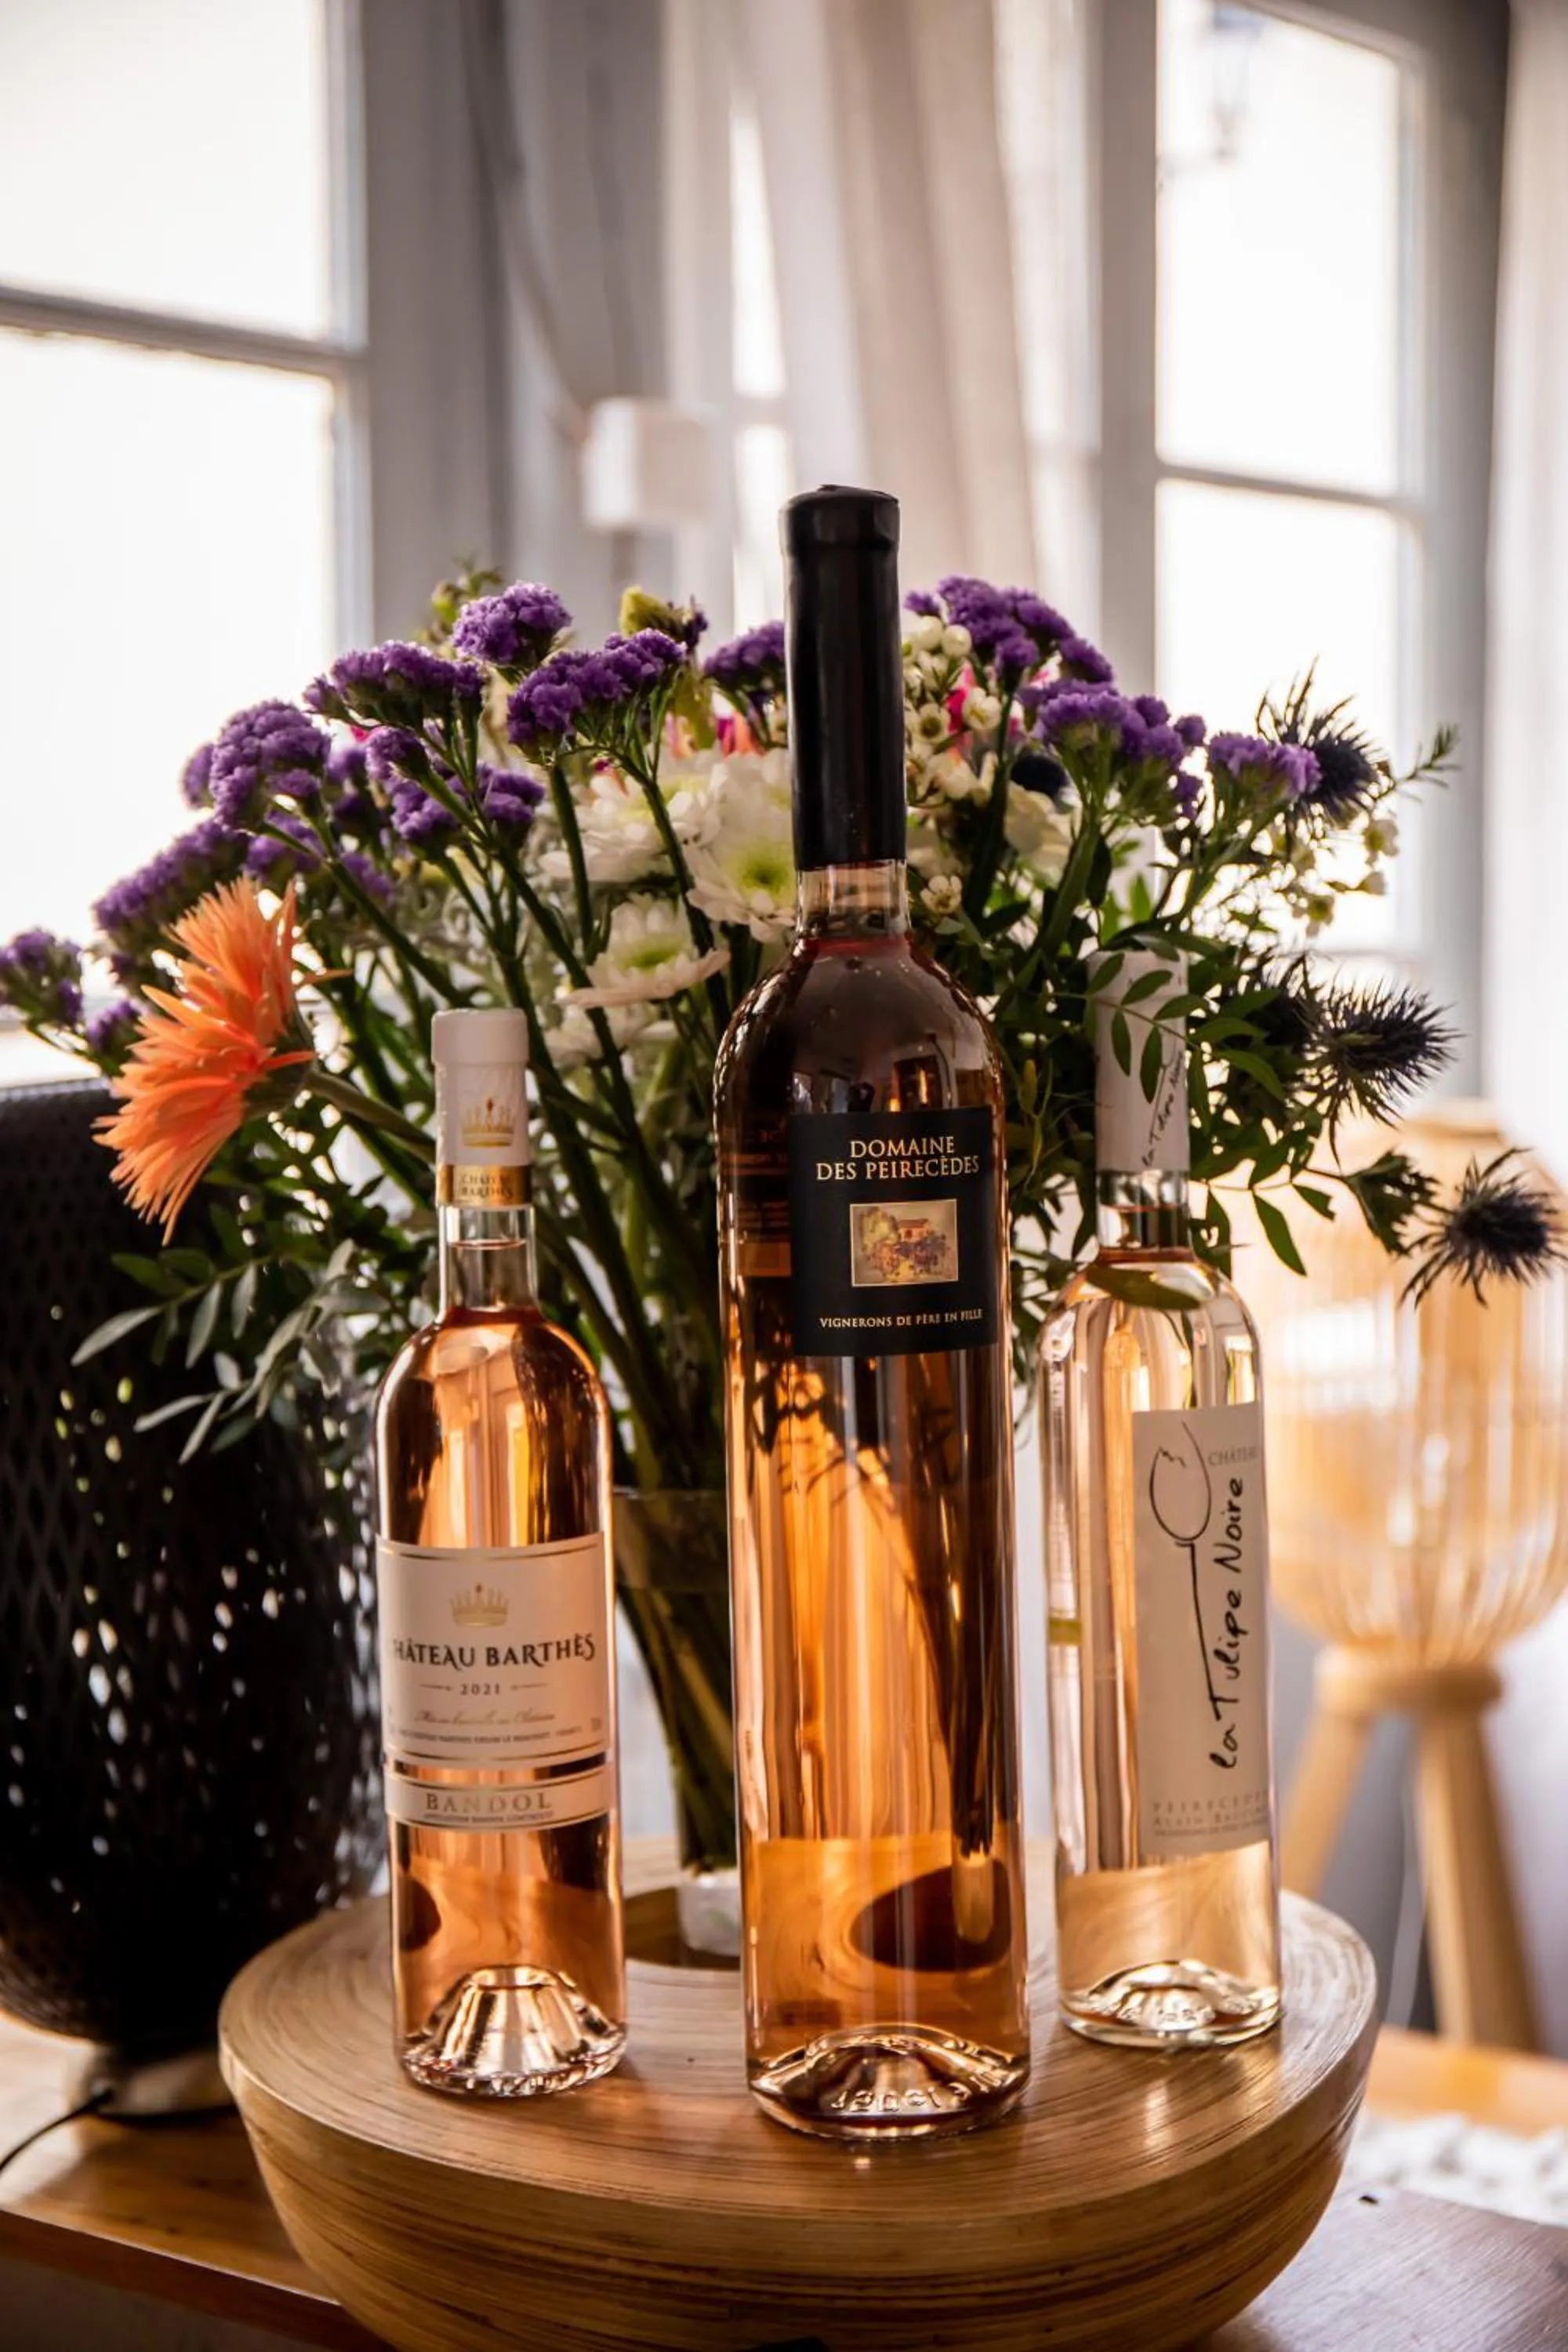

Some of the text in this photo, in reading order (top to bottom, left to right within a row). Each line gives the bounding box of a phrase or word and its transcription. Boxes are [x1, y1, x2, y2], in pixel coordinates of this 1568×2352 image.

[850, 1136, 955, 1158] DOMAINE
[816, 1155, 980, 1181] DES PEIRECÈDES
[819, 1316, 893, 1328] VIGNERONS
[896, 1315, 913, 1327] DE
[916, 1312, 942, 1325] PÈRE
[945, 1311, 958, 1323] EN
[1209, 1477, 1249, 1769] la Tulipe Noire
[393, 1632, 596, 1671] HÂTEAU BARTHÈS
[460, 1682, 501, 1696] 2021
[426, 1792, 553, 1813] BANDOL
